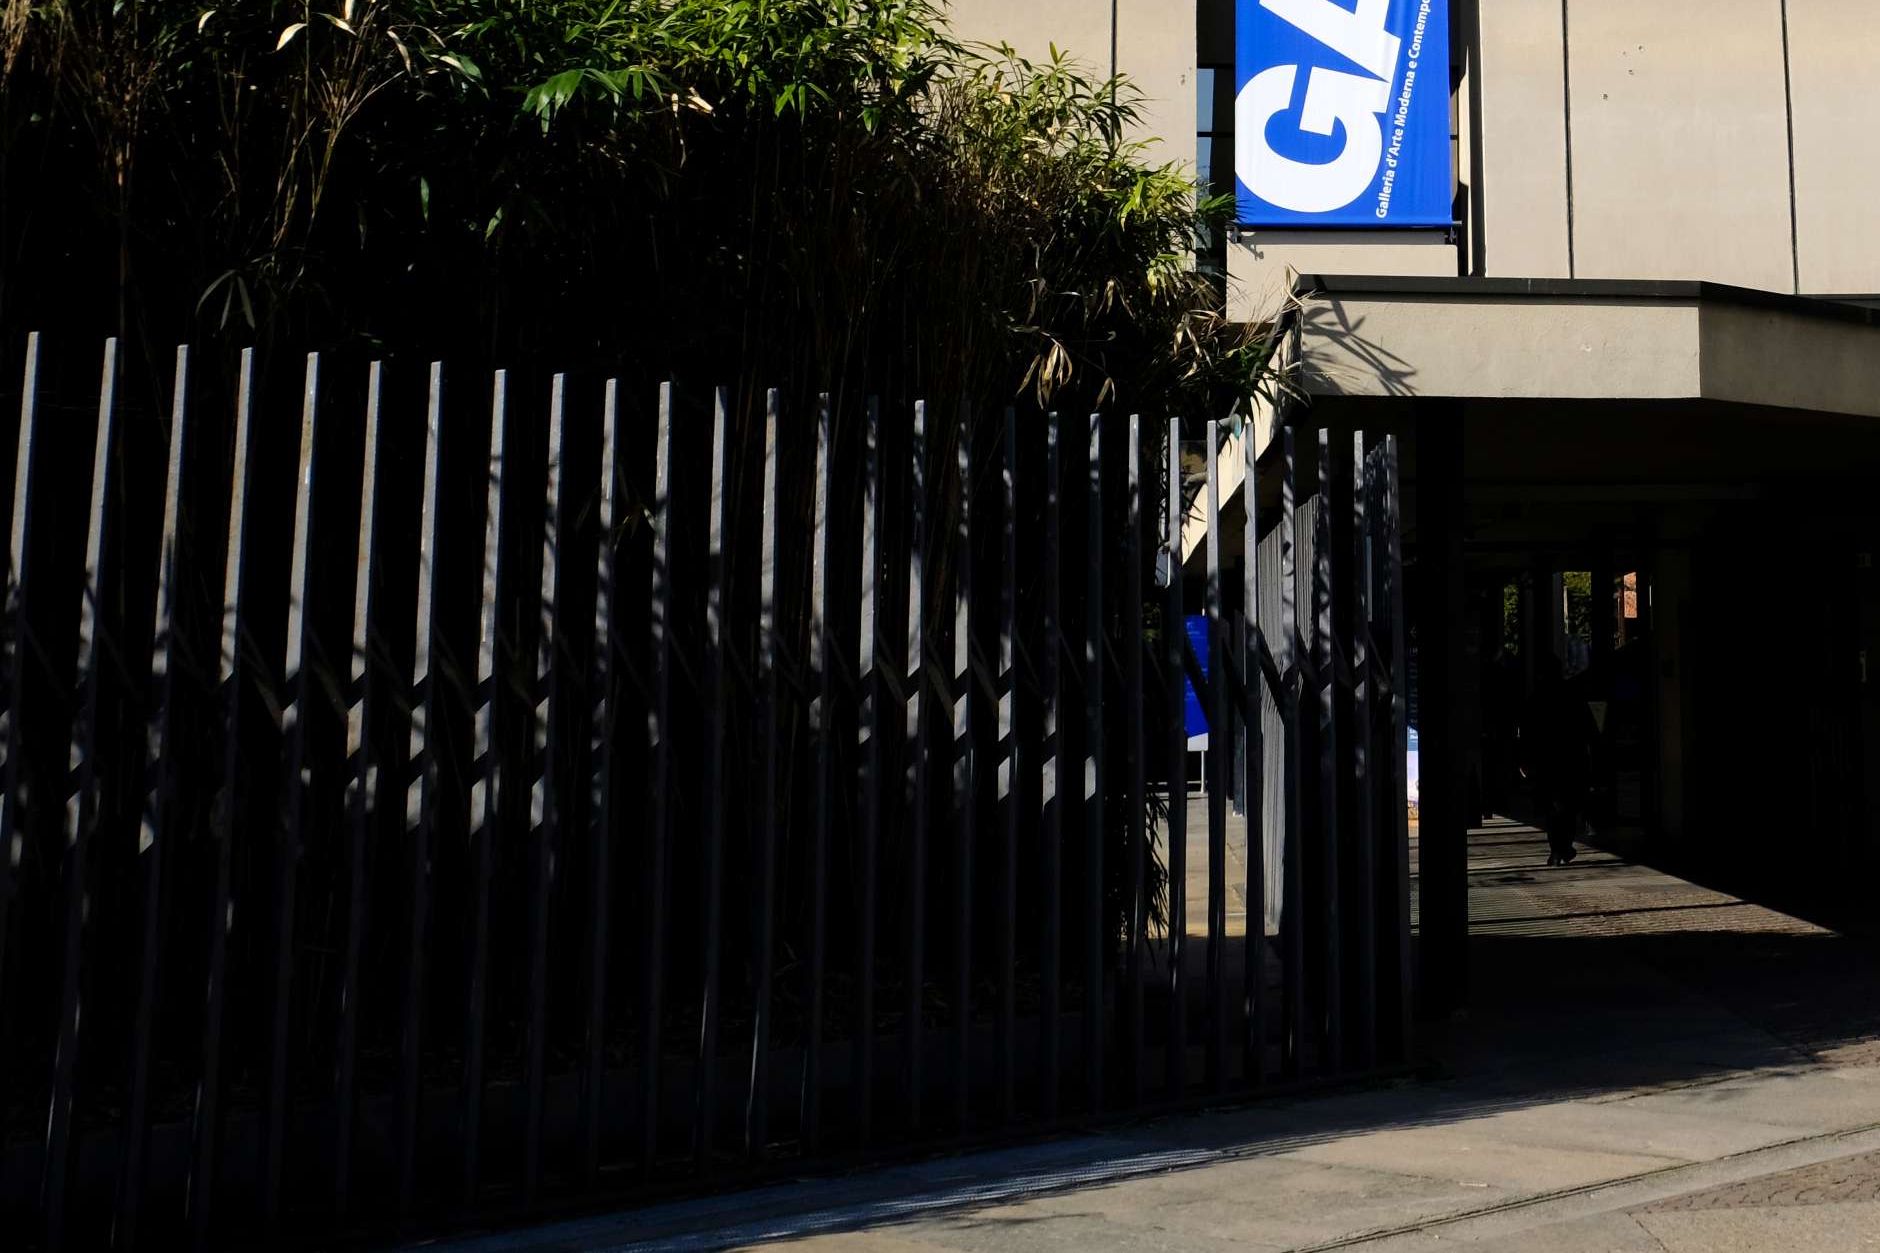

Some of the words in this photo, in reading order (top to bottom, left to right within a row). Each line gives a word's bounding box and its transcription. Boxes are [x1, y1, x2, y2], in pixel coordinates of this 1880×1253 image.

[1409, 60, 1417, 69] e
[1394, 71, 1415, 127] Moderna
[1386, 128, 1404, 168] d'Arte
[1376, 169, 1395, 219] Galleria
